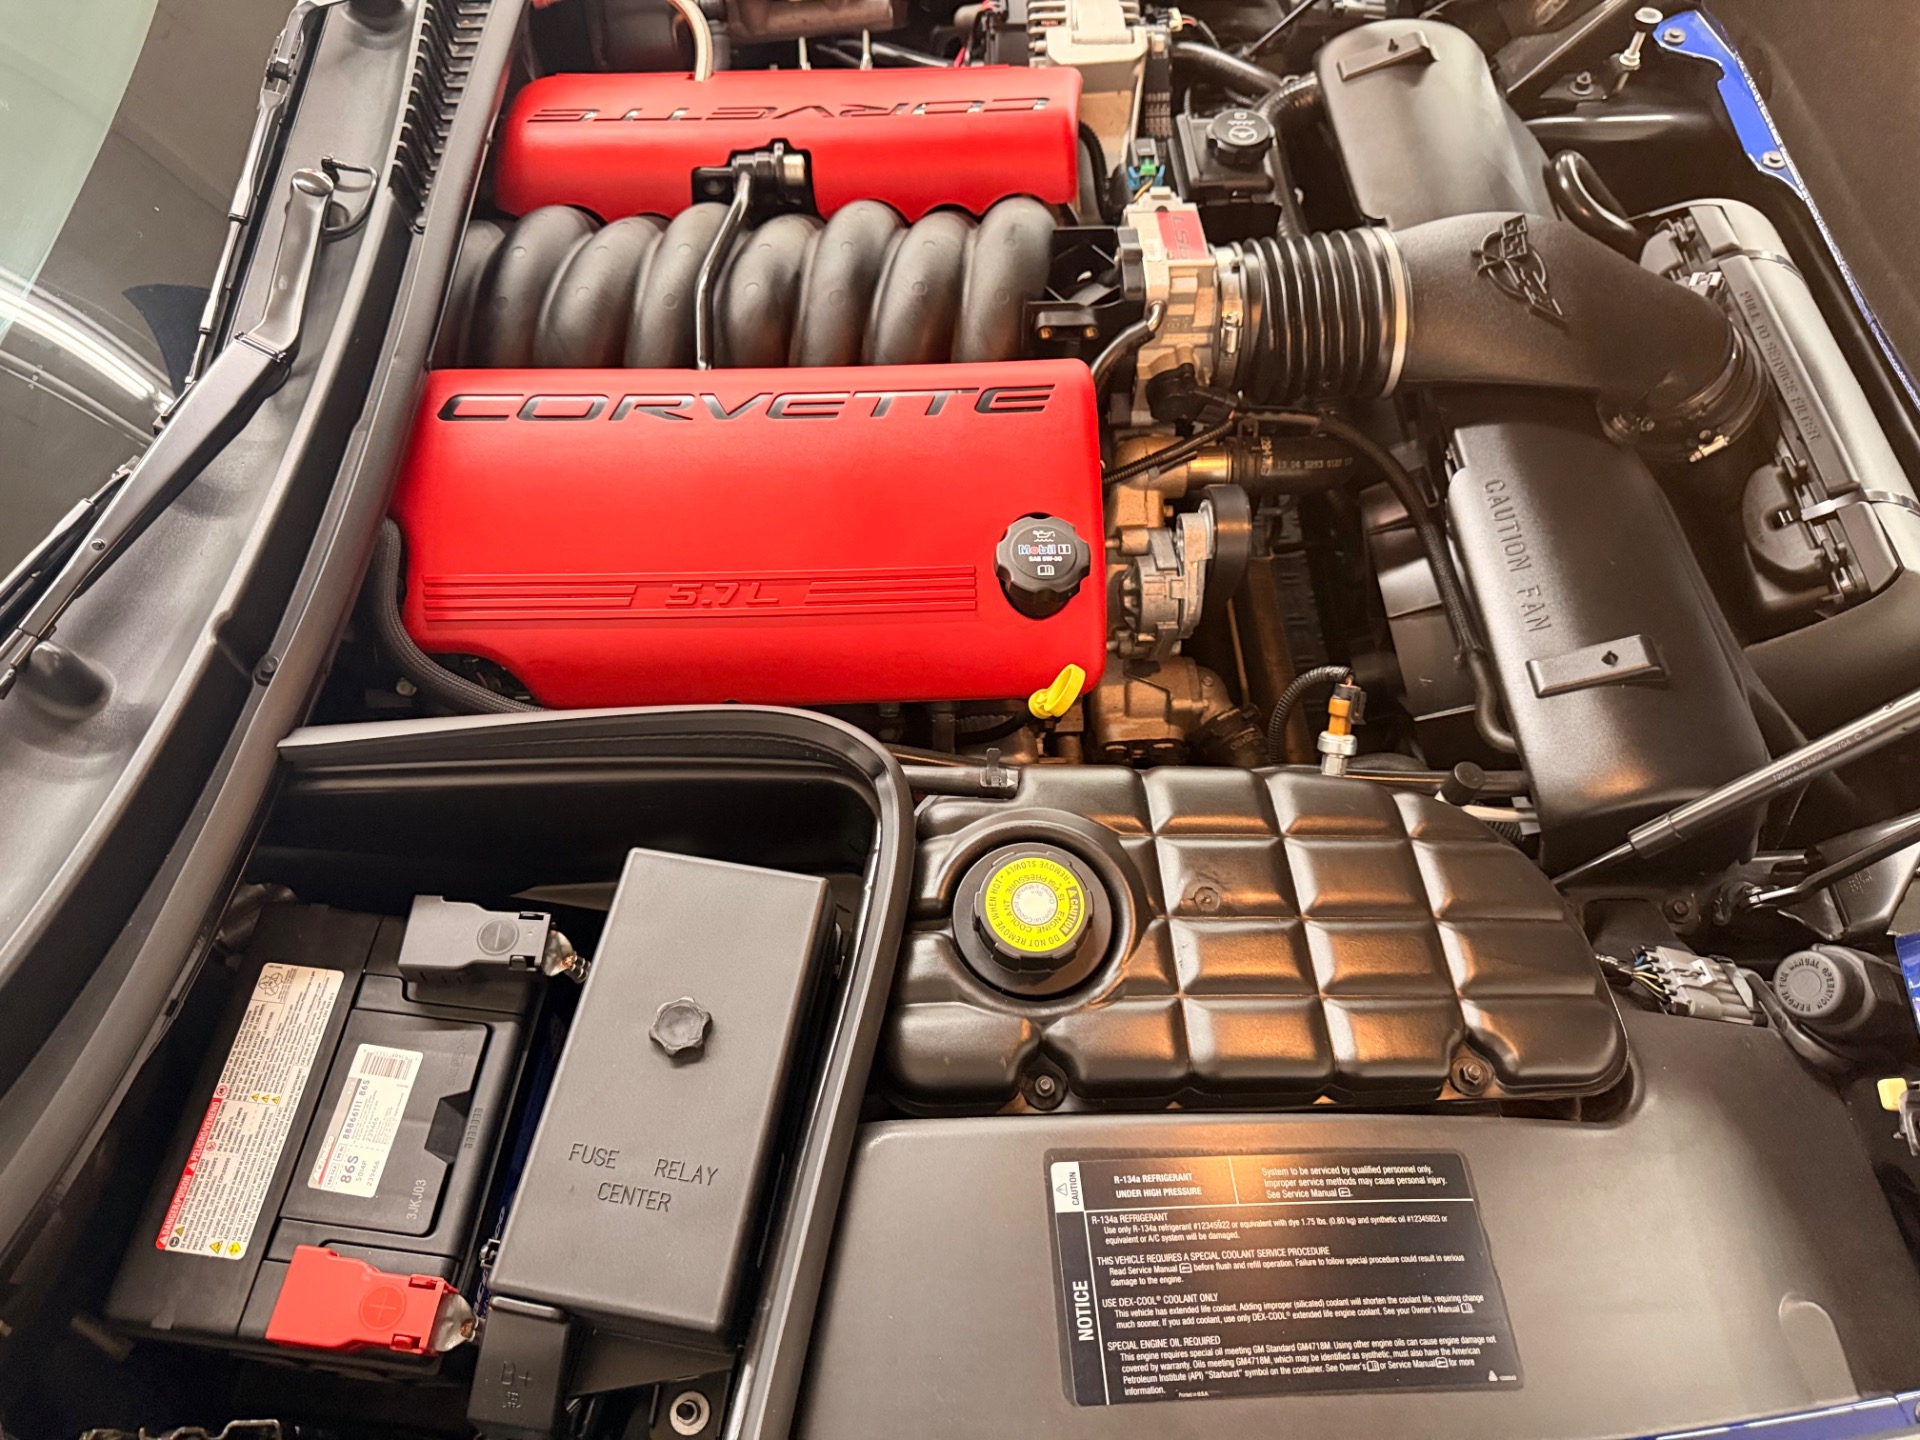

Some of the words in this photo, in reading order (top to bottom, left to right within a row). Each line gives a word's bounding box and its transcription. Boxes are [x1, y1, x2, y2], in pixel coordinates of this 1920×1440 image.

[527, 97, 1050, 122] CORVETTE
[1740, 290, 1760, 326] PULL
[1756, 324, 1771, 340] TO
[1765, 340, 1797, 396] SERVICE
[1791, 392, 1821, 441] FILTER
[437, 386, 1055, 421] CORVETTE
[1018, 544, 1056, 554] Mobil
[1484, 479, 1532, 572] CAUTION
[1517, 584, 1552, 632] FAN
[664, 581, 781, 608] 5.7L
[1005, 861, 1036, 876] SLOWLY
[1040, 860, 1070, 881] REMOVE
[992, 880, 1002, 894] HOT
[1006, 874, 1046, 894] PRESSURE
[1046, 878, 1060, 892] PSI
[988, 896, 1000, 920] WHEN
[1003, 900, 1032, 933] COOLANT
[1061, 899, 1079, 934] CAUTION
[1036, 910, 1064, 934] ENGINE
[996, 920, 1026, 946] REMOVE
[1028, 939, 1046, 947] NOT
[1048, 934, 1060, 944] DO
[1790, 958, 1820, 970] MANUAL
[1780, 972, 1789, 987] FOR
[1816, 968, 1834, 1010] OPERATION
[1782, 991, 1810, 1012] REMOVE
[342, 1100, 362, 1139] 88866111
[358, 1078, 370, 1096] 86S
[161, 1174, 192, 1236] DANGER/POISON
[190, 1100, 220, 1161] PELIGRO/VENENO
[339, 1154, 359, 1183] 86S
[568, 1143, 620, 1169] FUSE
[654, 1158, 719, 1186] RELAY
[1261, 1167, 1289, 1177] System
[1289, 1167, 1298, 1175] to
[1309, 1166, 1340, 1174] serviced
[1340, 1166, 1351, 1174] by
[1350, 1166, 1382, 1174] qualified
[1113, 1174, 1140, 1183] R-134a
[1141, 1172, 1192, 1182] REFRIGERANT
[1264, 1179, 1297, 1188] Improper
[1395, 1176, 1426, 1185] personal
[1425, 1176, 1447, 1184] injury.
[406, 1179, 427, 1220] 3JKJ03
[597, 1182, 672, 1212] CENTER
[1115, 1189, 1142, 1198] UNDER
[1142, 1188, 1161, 1196] HIGH
[1162, 1186, 1202, 1195] PRESSURE
[1265, 1190, 1281, 1198] See
[1281, 1189, 1309, 1198] Service
[1309, 1188, 1337, 1197] Manual
[1090, 1214, 1118, 1224] R-134a
[1118, 1212, 1168, 1222] REFRIGERANT
[1096, 1256, 1114, 1265] THIS
[1114, 1254, 1145, 1264] VEHICLE
[1145, 1252, 1182, 1262] REQUIRES
[1182, 1252, 1189, 1261] A
[1189, 1250, 1220, 1260] SPECIAL
[1220, 1249, 1255, 1259] COOLANT
[1256, 1248, 1286, 1257] SERVICE
[1286, 1246, 1330, 1256] PROCEDURE
[1108, 1267, 1126, 1275] Read
[1127, 1265, 1152, 1274] Service
[1152, 1264, 1178, 1273] Manual
[1192, 1262, 1214, 1270] before
[1246, 1260, 1261, 1268] refill
[1294, 1258, 1317, 1266] Failure
[1344, 1256, 1368, 1265] special
[1367, 1255, 1400, 1264] procedure
[1110, 1278, 1138, 1287] damage
[1158, 1274, 1183, 1284] engine.
[1101, 1298, 1117, 1307] USE
[1162, 1293, 1198, 1304] COOLANT
[1198, 1292, 1218, 1302] ONLY
[1129, 1308, 1154, 1316] vehicle
[1168, 1305, 1199, 1314] extended
[1238, 1302, 1262, 1312] Adding
[1262, 1300, 1293, 1310] improper
[1324, 1298, 1349, 1306] coolant
[1361, 1296, 1386, 1304] shorten
[1461, 1294, 1484, 1302] change
[1072, 1280, 1094, 1342] NOTICE
[1115, 1320, 1135, 1328] much
[1181, 1316, 1195, 1324] add
[1236, 1313, 1251, 1322] only
[1291, 1310, 1322, 1318] extended
[1333, 1308, 1356, 1318] engine
[1382, 1306, 1395, 1314] See
[1410, 1305, 1437, 1313] Owner's
[1436, 1304, 1458, 1312] Manual
[1106, 1340, 1138, 1350] SPECIAL
[1139, 1338, 1168, 1348] ENGINE
[1168, 1337, 1180, 1347] OIL
[1182, 1335, 1221, 1346] REQUIRED
